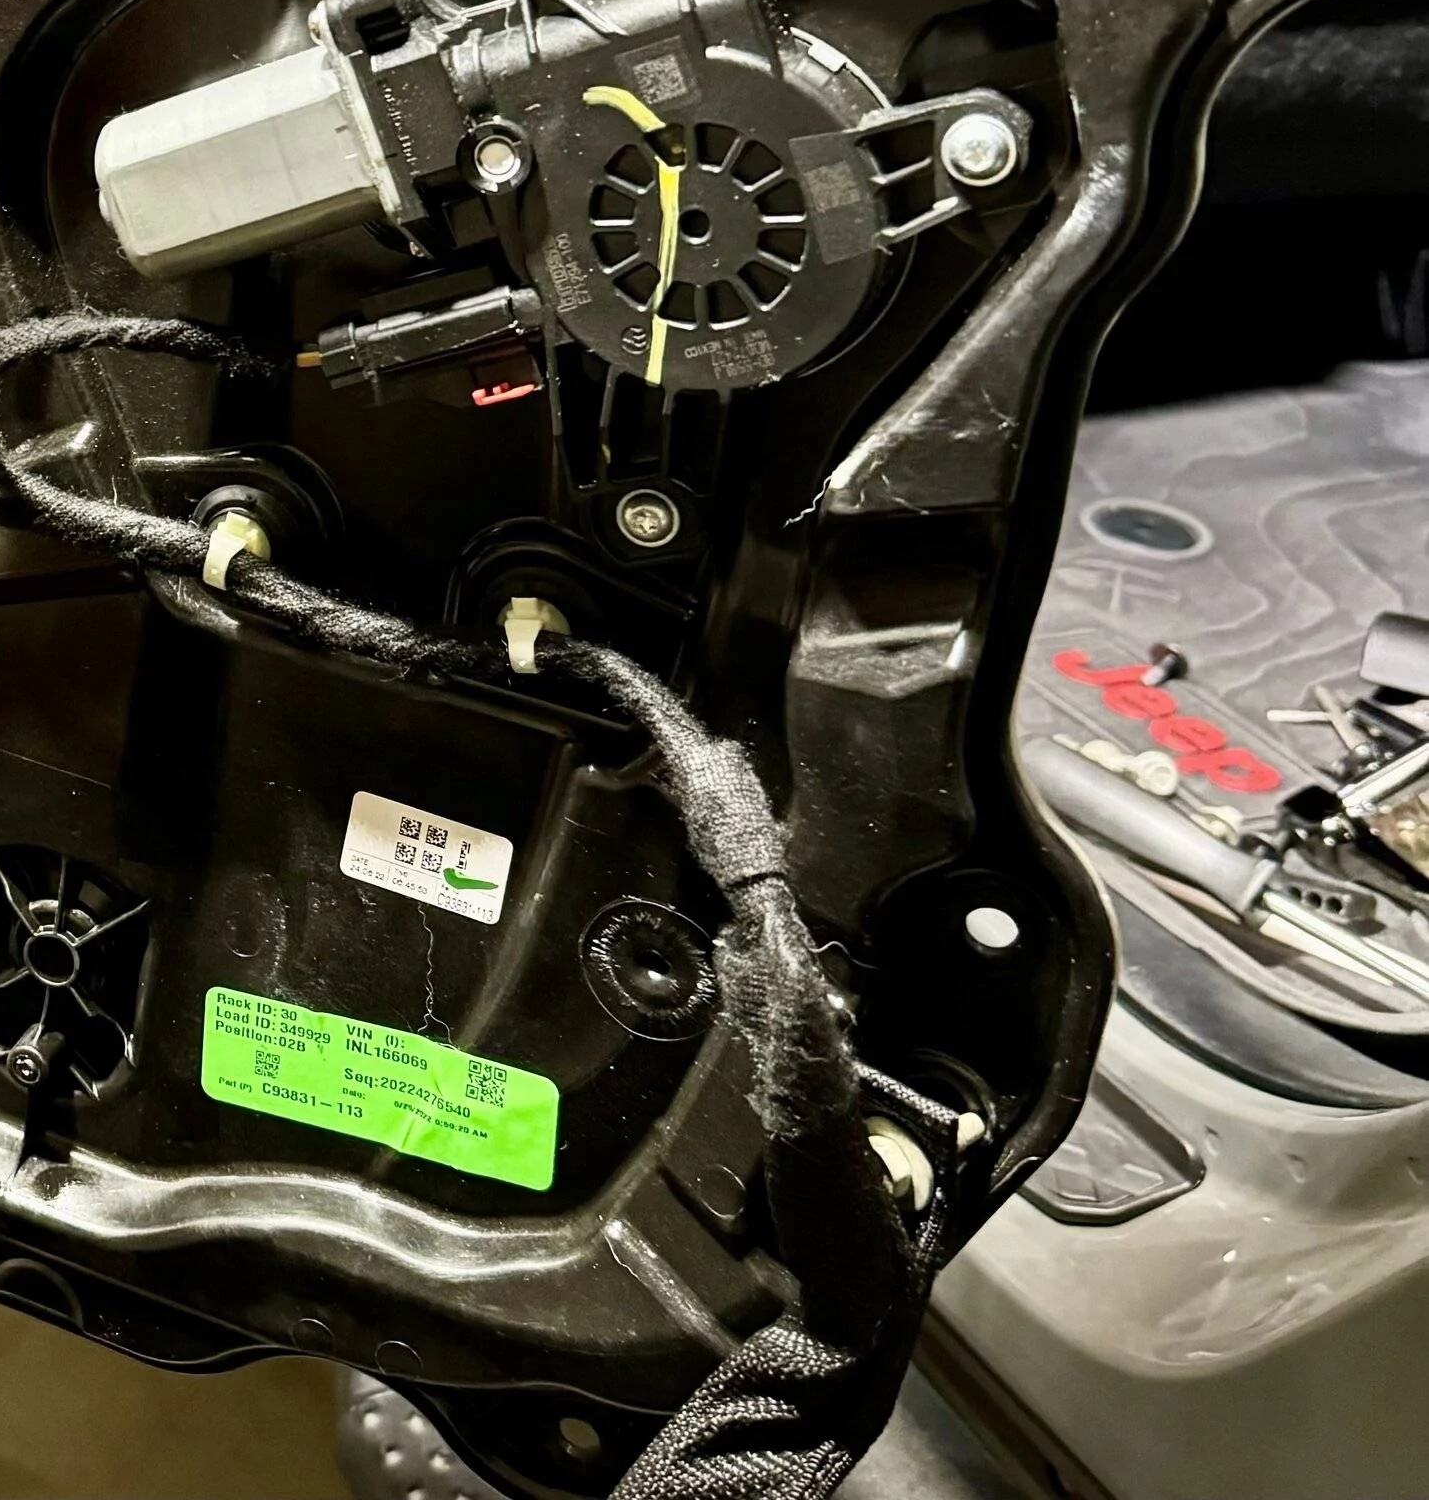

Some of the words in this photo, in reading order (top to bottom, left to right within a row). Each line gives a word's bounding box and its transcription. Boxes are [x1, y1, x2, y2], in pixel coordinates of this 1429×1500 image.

[1051, 647, 1283, 794] Jeep
[217, 992, 251, 1010] Rack
[257, 1002, 277, 1017] ID:
[280, 1008, 298, 1021] 30
[216, 1006, 250, 1024] Load
[255, 1016, 276, 1031] ID:
[280, 1022, 331, 1044] 349929
[346, 1024, 373, 1040] VIN
[471, 1128, 488, 1139] AM
